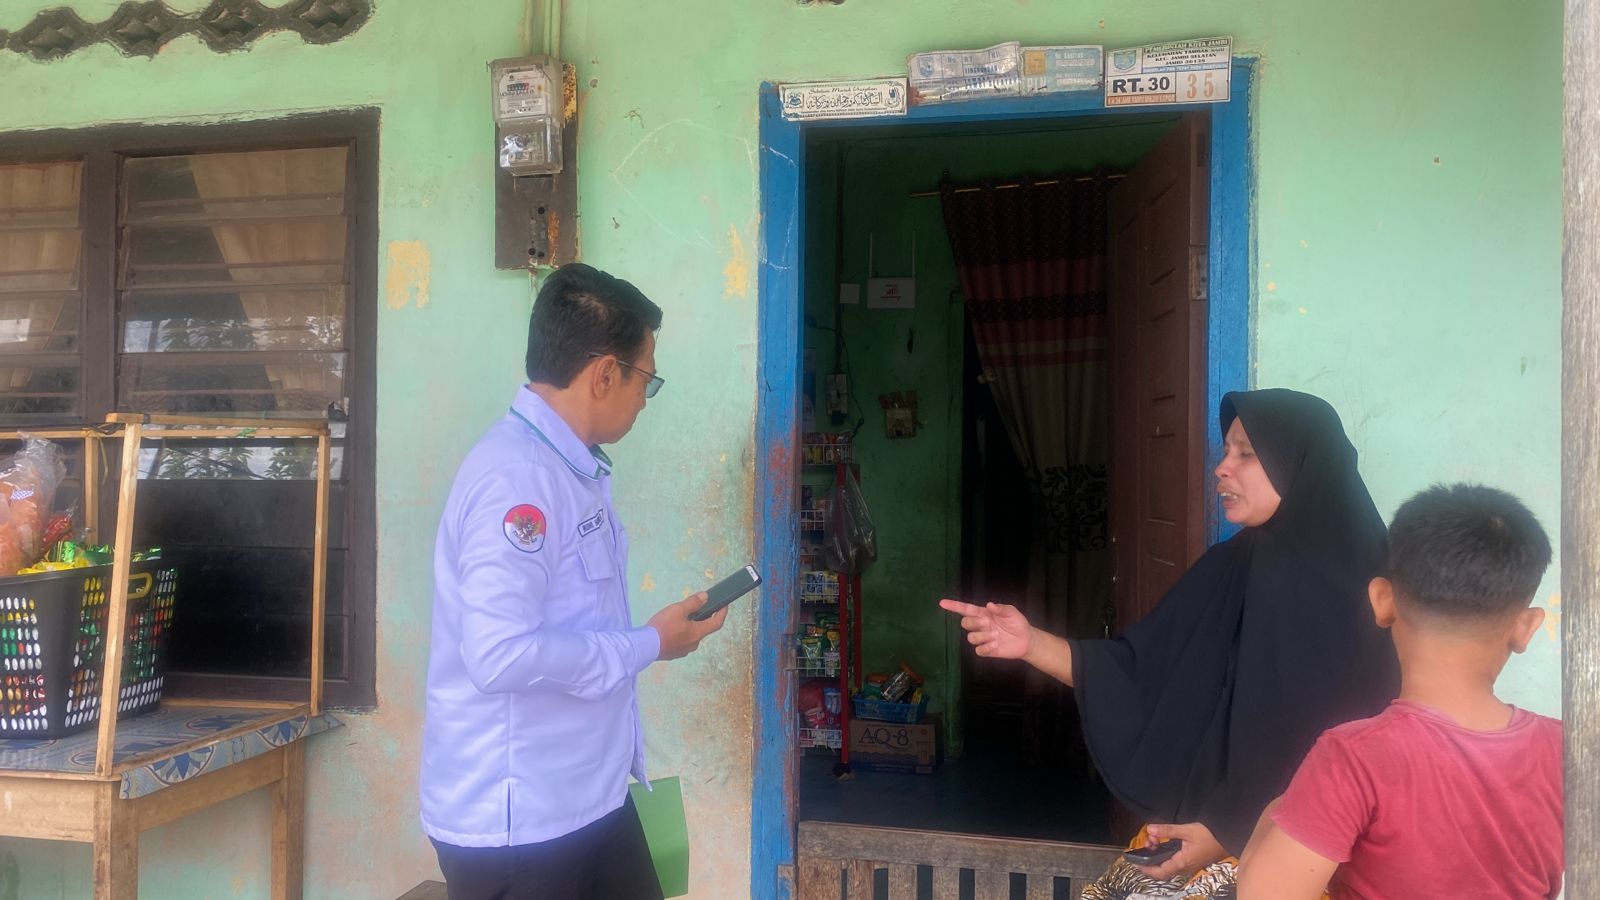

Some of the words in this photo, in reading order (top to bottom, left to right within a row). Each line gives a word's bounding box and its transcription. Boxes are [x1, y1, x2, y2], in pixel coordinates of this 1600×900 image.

[1113, 78, 1144, 93] RT.
[1148, 76, 1170, 91] 30
[859, 728, 909, 746] AQ-8
